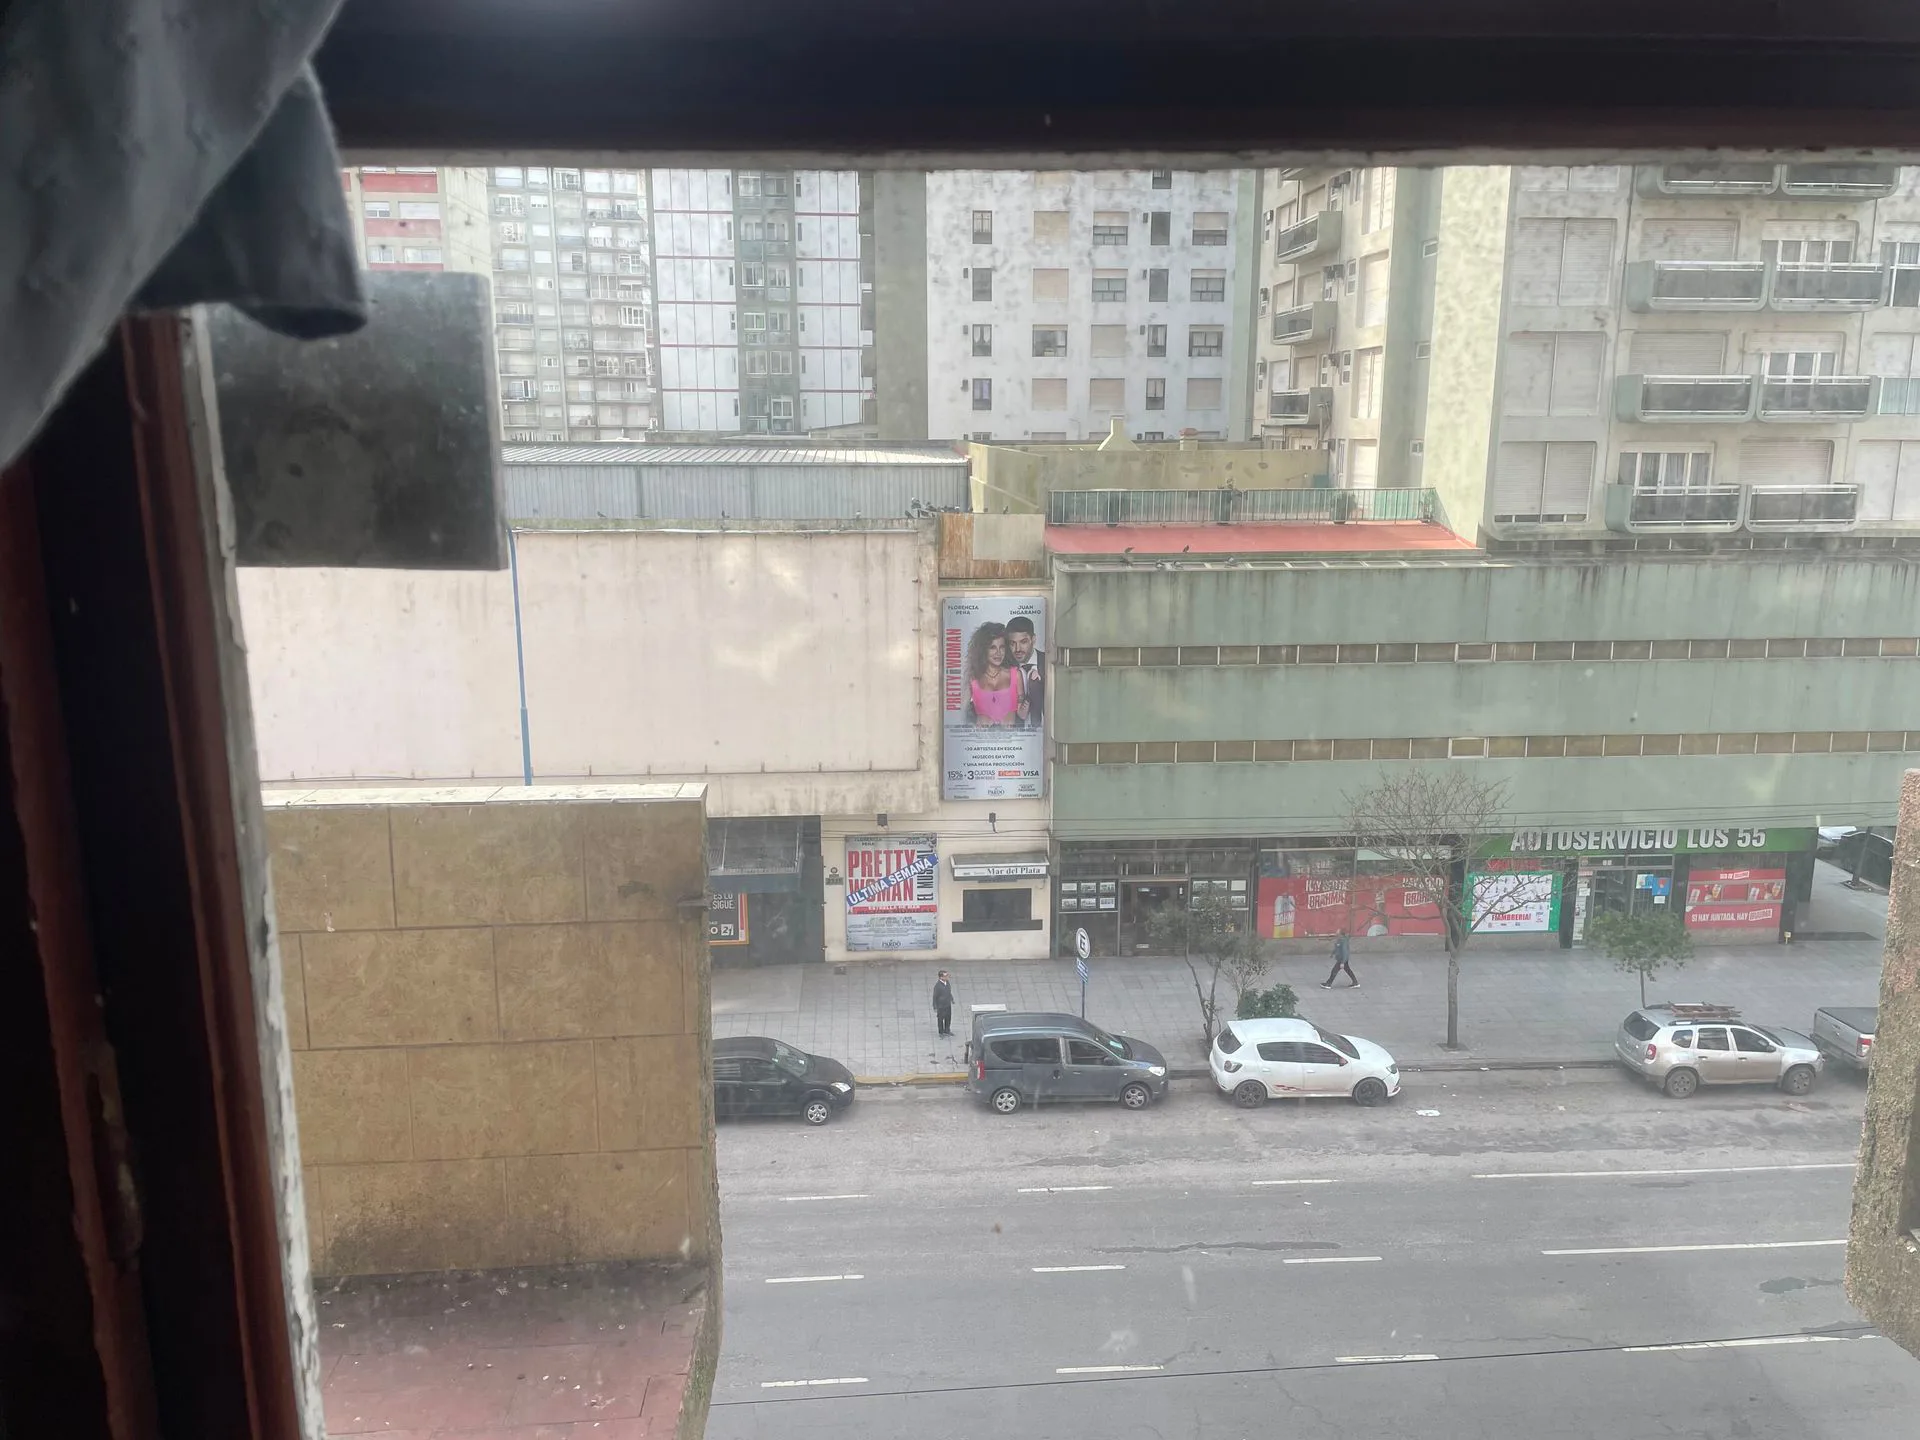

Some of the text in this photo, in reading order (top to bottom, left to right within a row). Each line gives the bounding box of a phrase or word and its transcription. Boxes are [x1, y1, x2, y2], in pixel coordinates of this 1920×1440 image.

[946, 628, 962, 668] WOMAN
[946, 675, 962, 711] PRETTY
[967, 770, 974, 780] 3
[1511, 827, 1767, 851] AUTOSERVICIO LOS 55
[848, 849, 916, 878] PRETTY
[987, 868, 1003, 876] Mar
[1006, 867, 1018, 875] del
[848, 879, 889, 905] ULTIMA
[888, 858, 932, 885] SEMANA
[917, 893, 934, 901] EL
